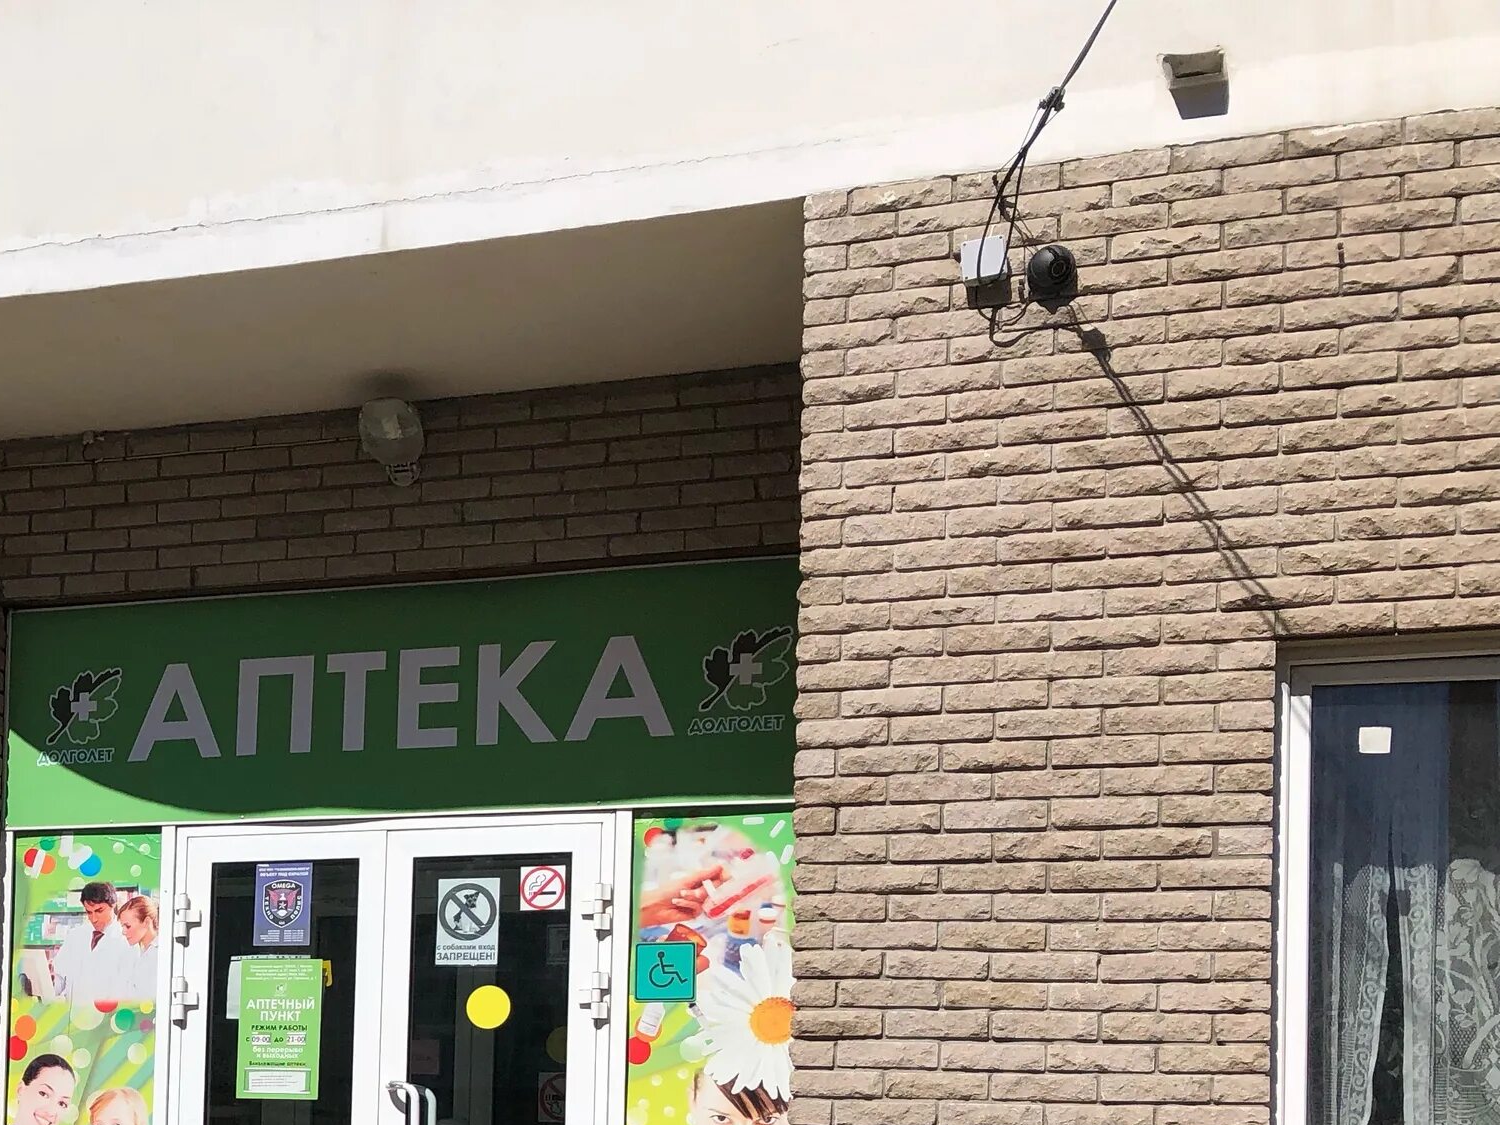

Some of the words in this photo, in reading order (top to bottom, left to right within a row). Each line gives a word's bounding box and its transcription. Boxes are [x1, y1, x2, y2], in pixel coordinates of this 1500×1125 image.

[127, 635, 675, 763] АПТЕКА
[687, 714, 786, 736] ДОЛГОЛЕТ
[36, 747, 115, 767] ДОЛГОЛЕТ
[442, 943, 477, 951] собаками
[436, 952, 496, 961] ЗАПРЕЩЕН!
[246, 996, 315, 1010] АПТЕЧНЫЙ
[260, 1010, 301, 1021] ПУНКТ
